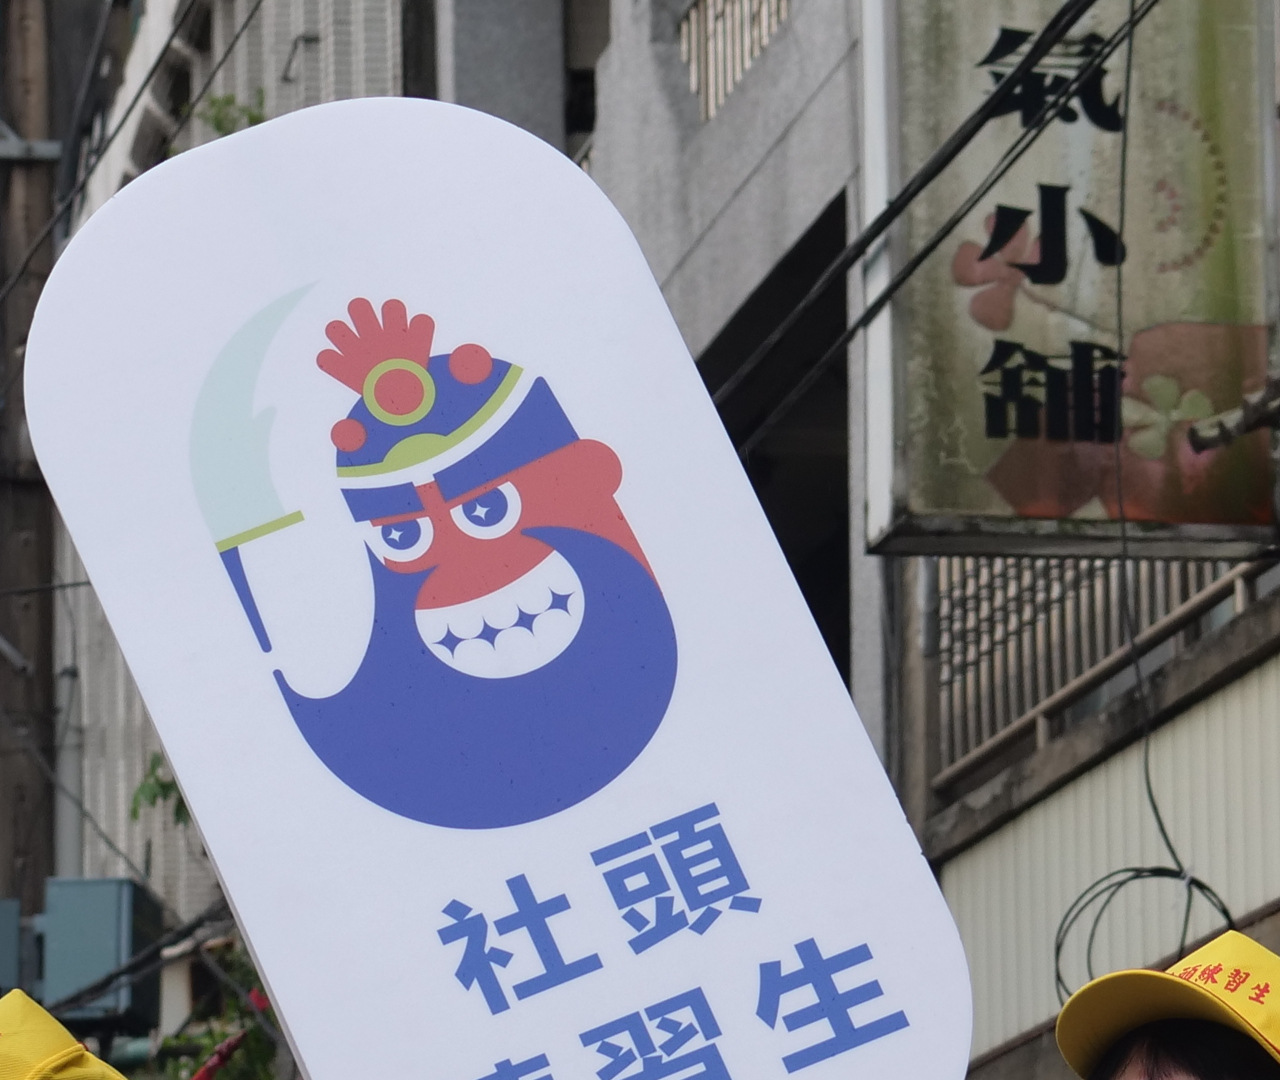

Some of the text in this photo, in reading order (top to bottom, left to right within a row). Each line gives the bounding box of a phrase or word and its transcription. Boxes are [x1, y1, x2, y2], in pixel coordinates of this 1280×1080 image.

[437, 802, 762, 1016] 社頭
[1169, 962, 1271, 1005] 頭練習生
